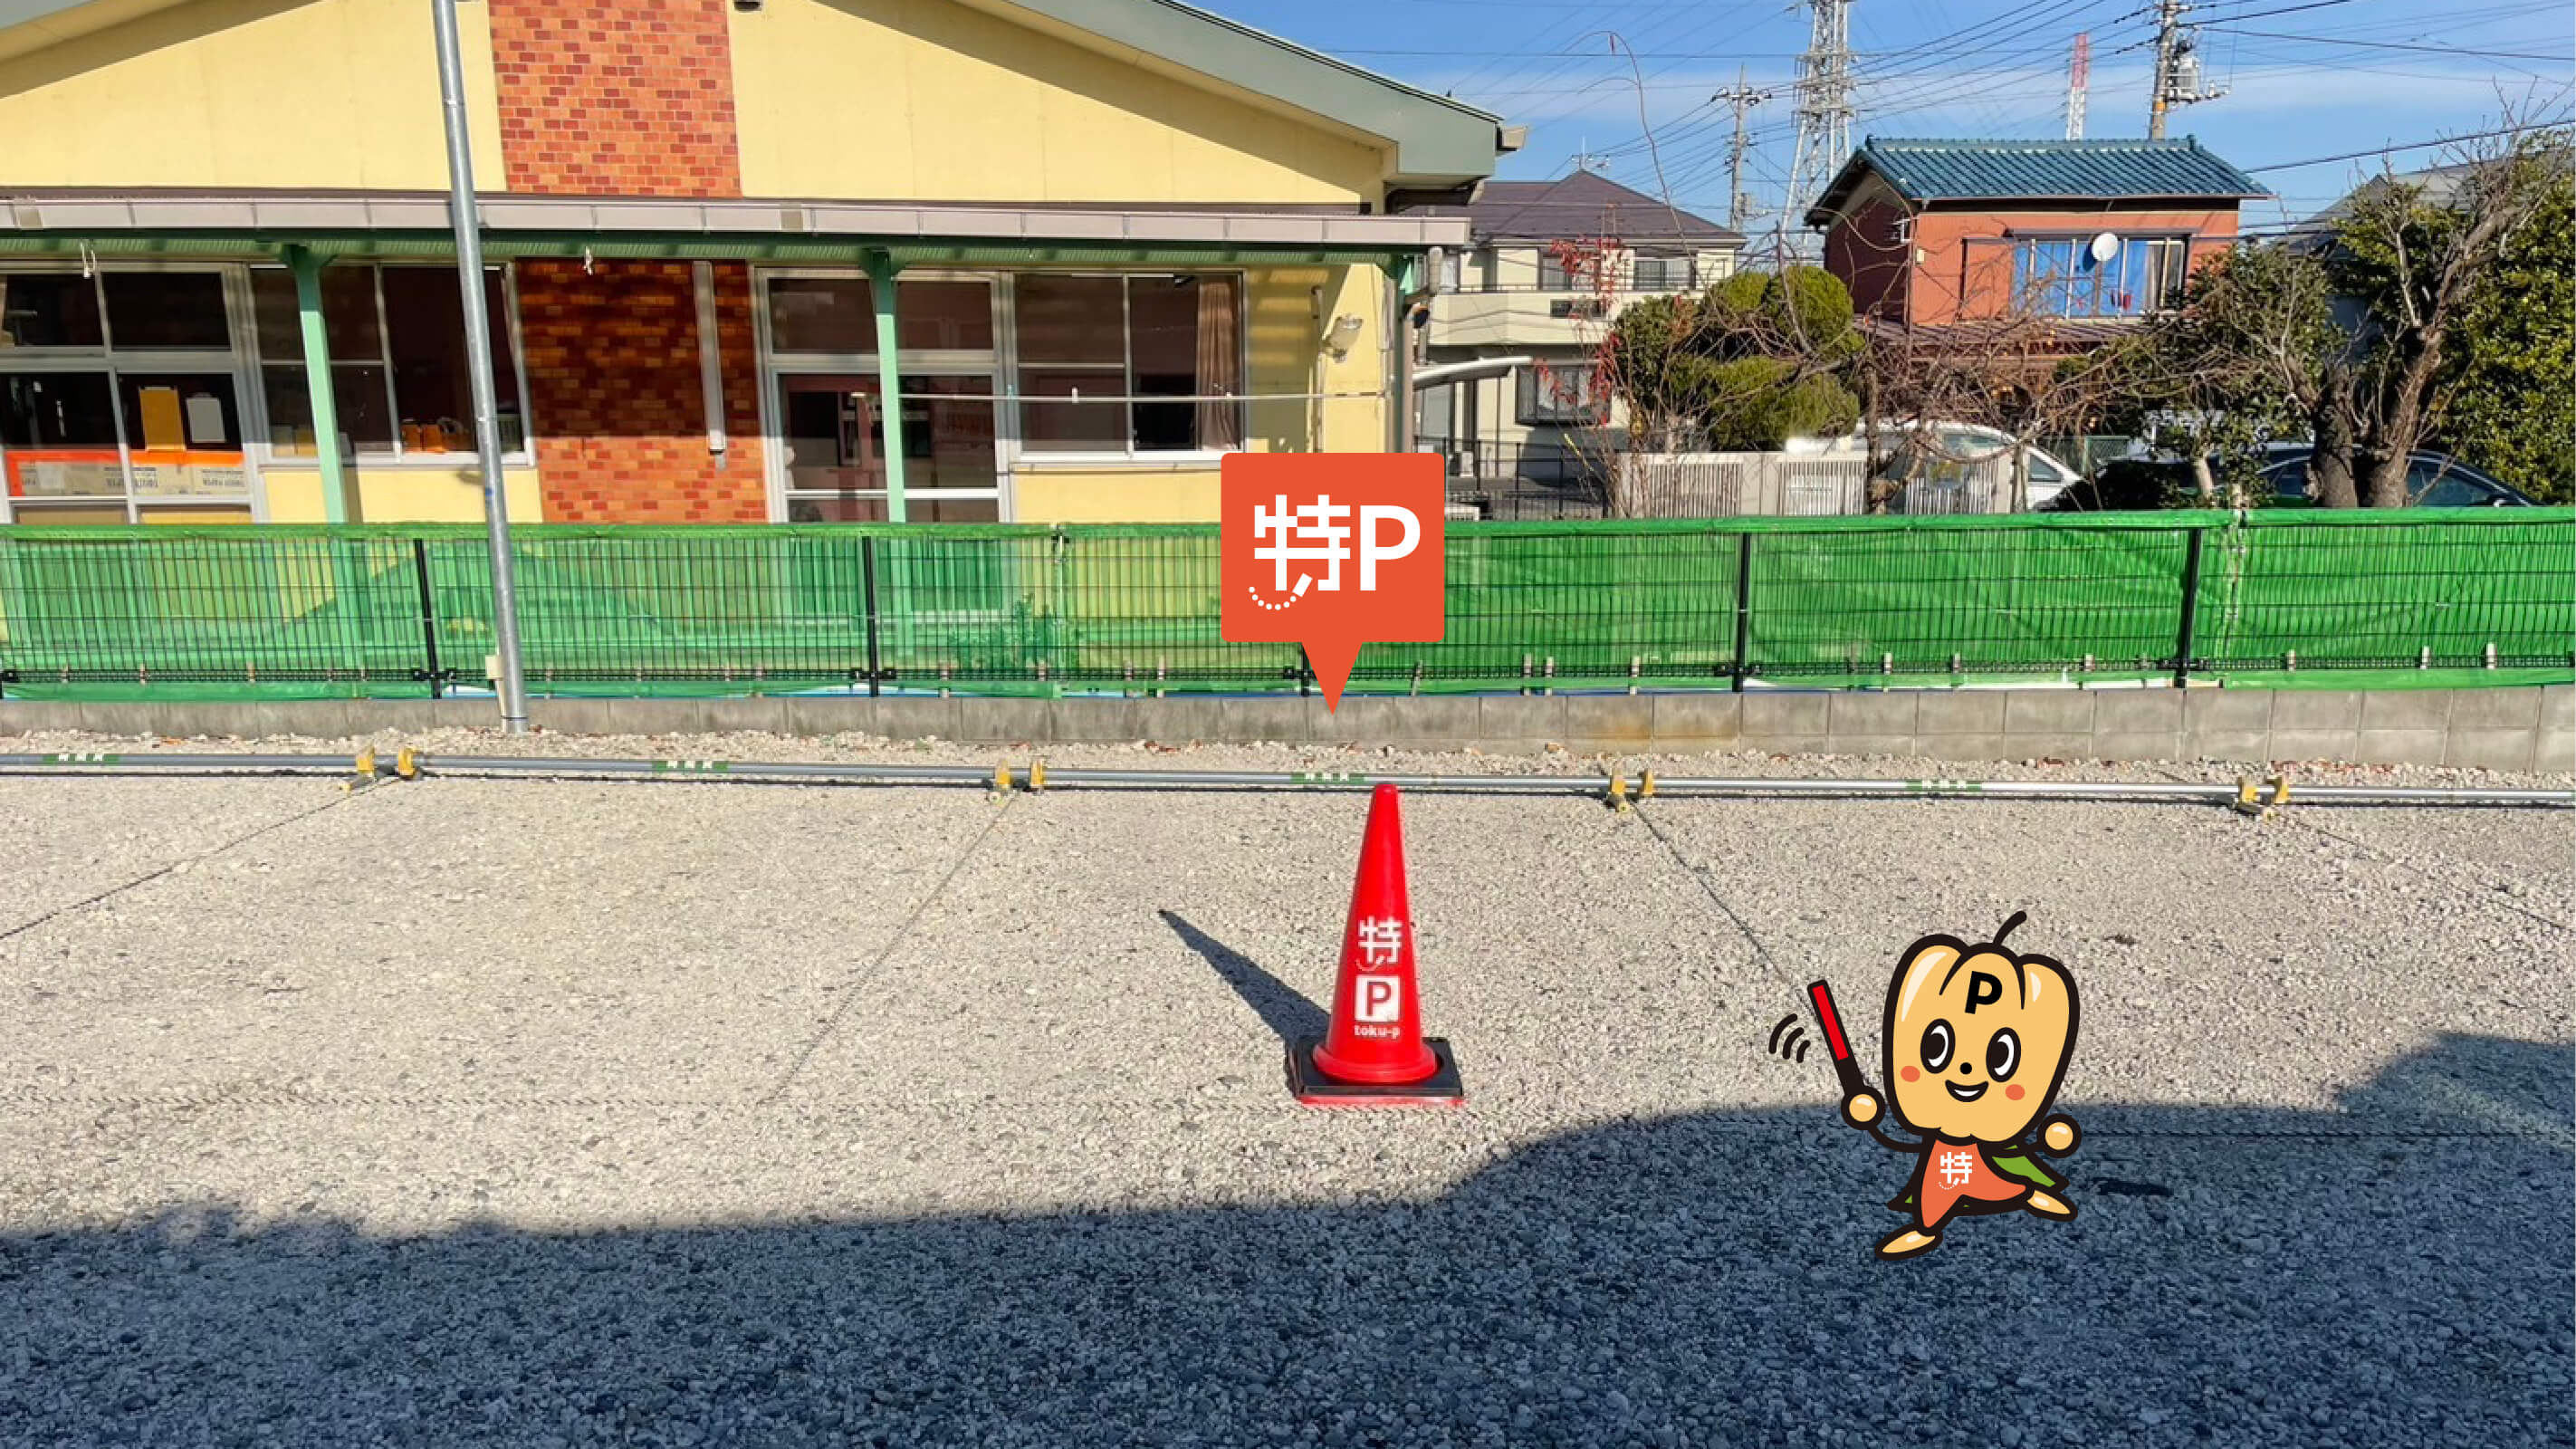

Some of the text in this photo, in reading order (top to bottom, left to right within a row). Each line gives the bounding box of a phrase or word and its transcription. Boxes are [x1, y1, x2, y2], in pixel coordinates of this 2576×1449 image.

[1357, 916, 1403, 965] 特
[1365, 981, 1393, 1016] P
[1354, 1024, 1401, 1040] toku-p
